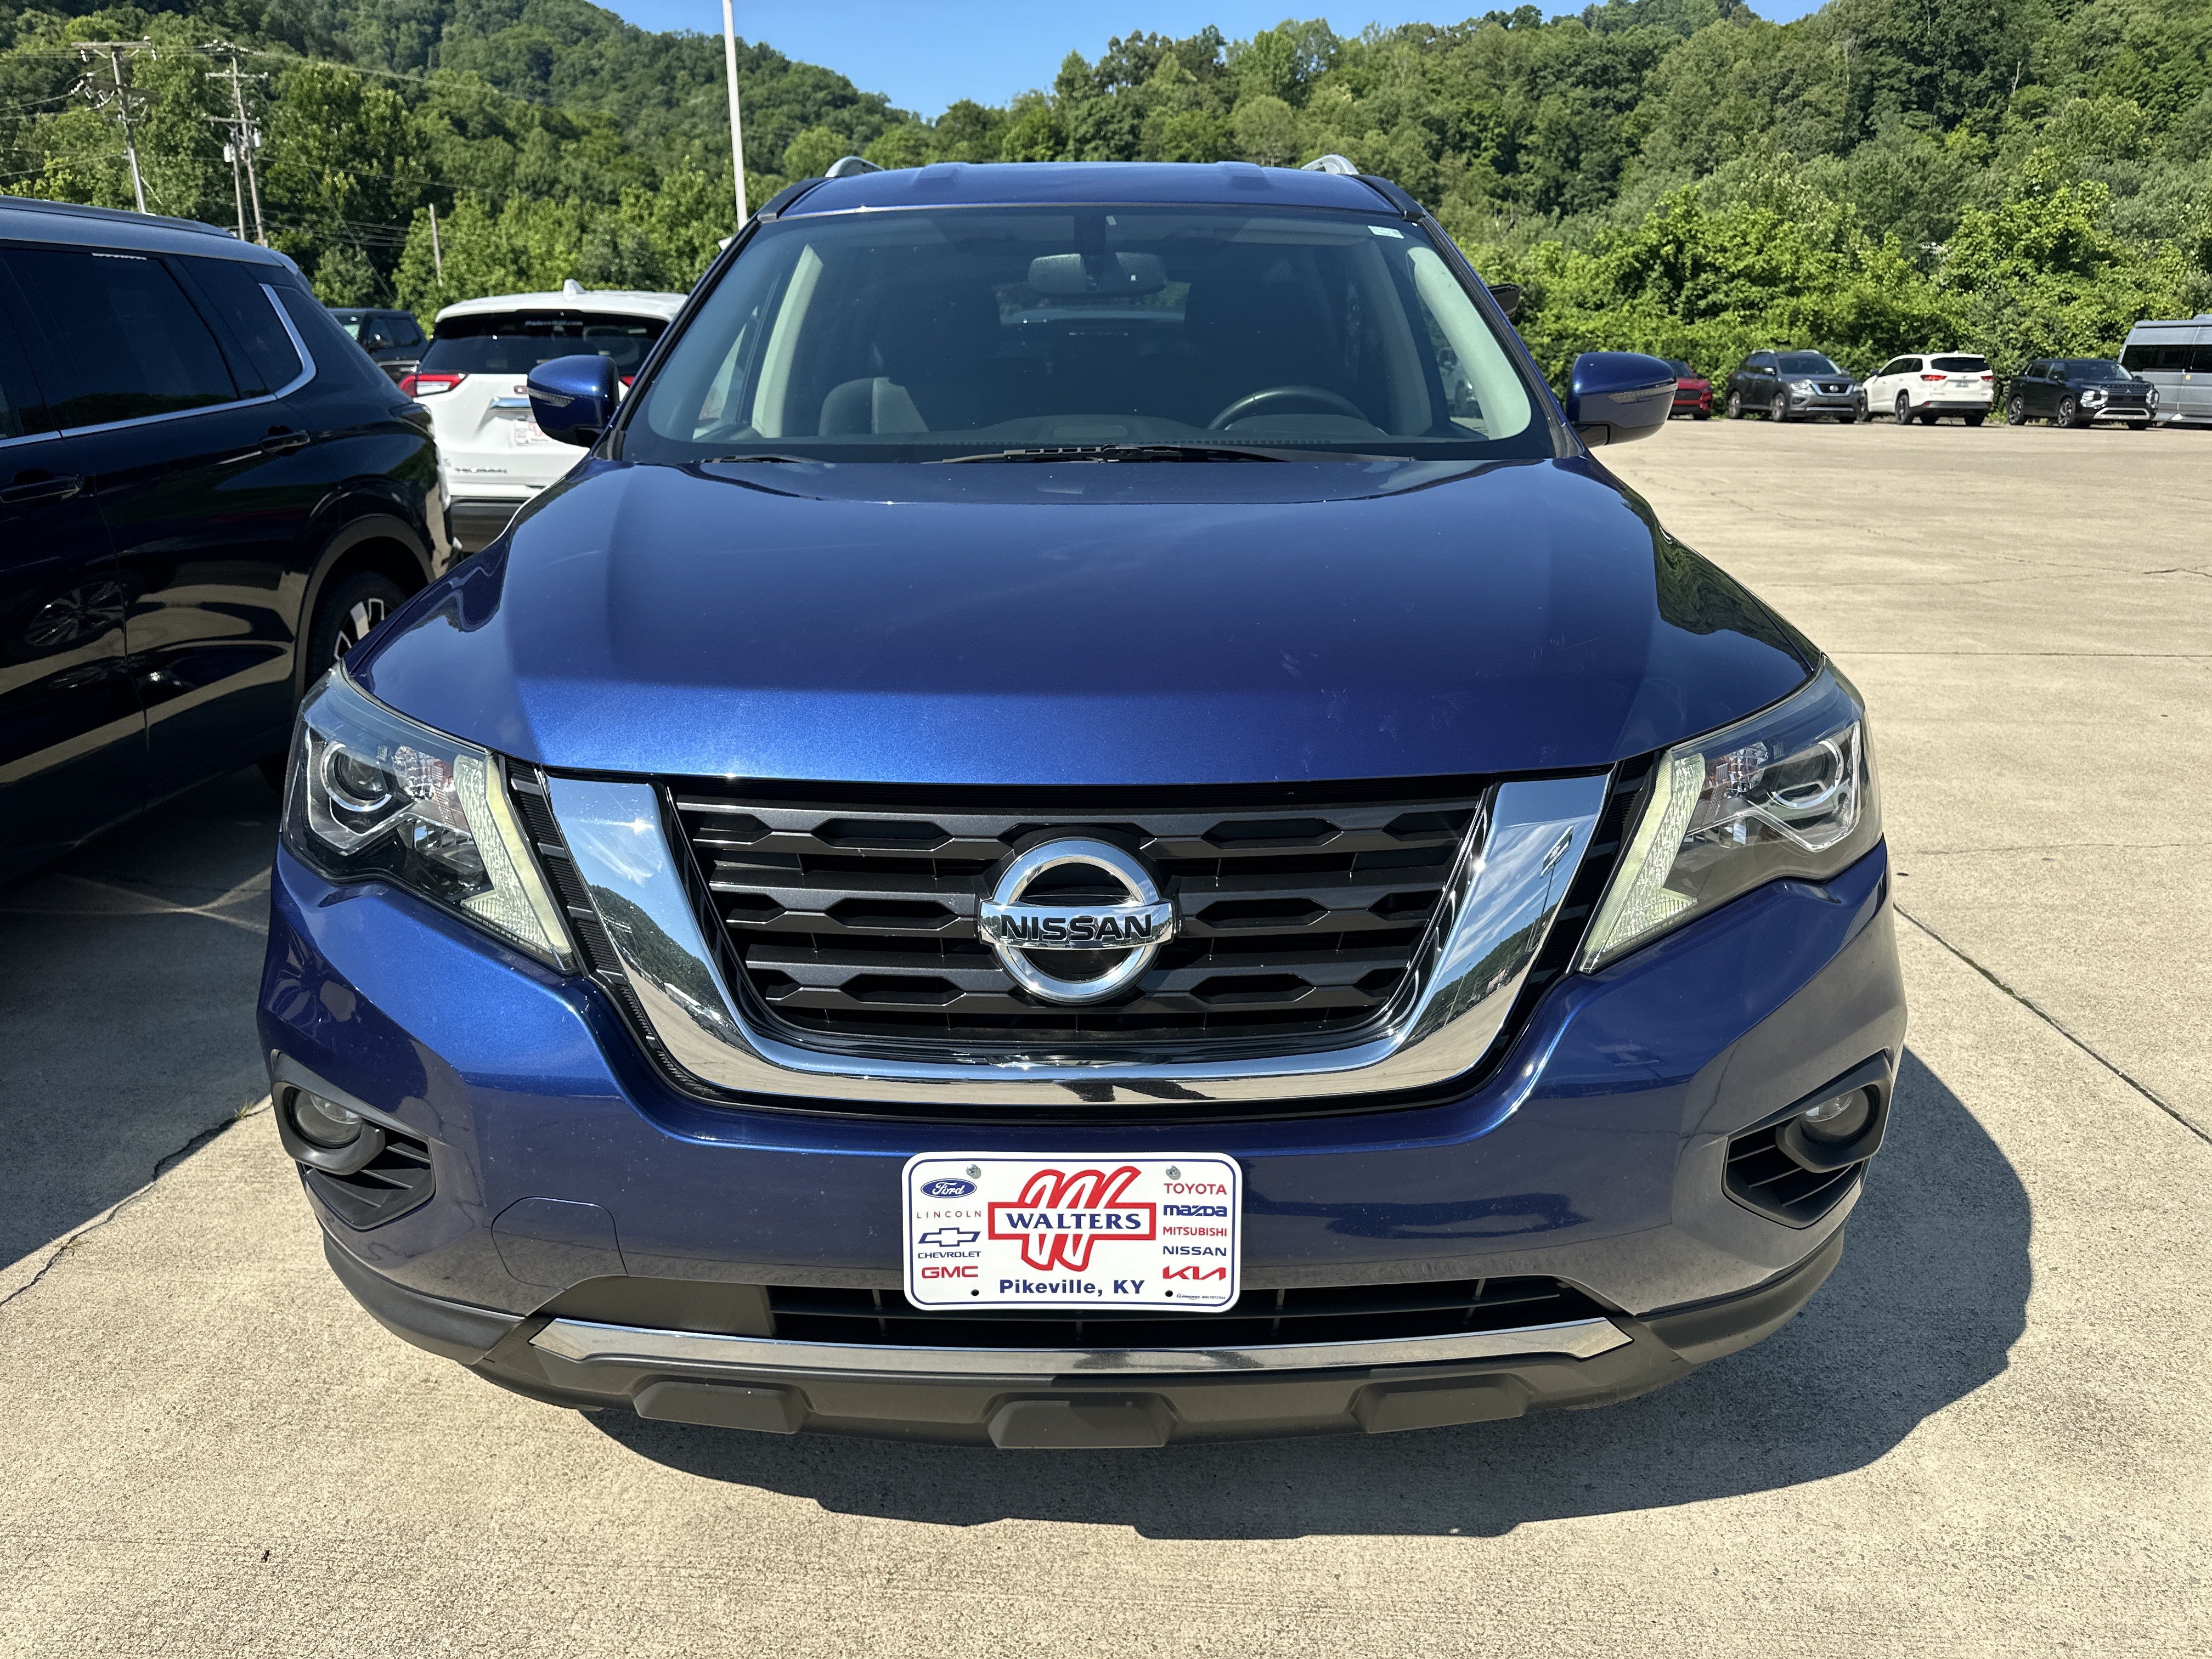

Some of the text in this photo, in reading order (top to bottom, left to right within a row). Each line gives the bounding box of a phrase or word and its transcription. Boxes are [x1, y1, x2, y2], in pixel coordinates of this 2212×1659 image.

[1001, 914, 1152, 941] NISSAN
[932, 1182, 966, 1195] Ford
[1164, 1183, 1227, 1195] TOYOTA
[917, 1211, 981, 1219] LINCOLN
[1005, 1213, 1141, 1229] WALTERS
[1163, 1227, 1227, 1237] MITSUBISHI
[1163, 1245, 1227, 1256] NISSAN
[922, 1266, 978, 1279] GMC
[1163, 1266, 1226, 1280] KIA
[1000, 1279, 1145, 1297] Pikeville, KY
